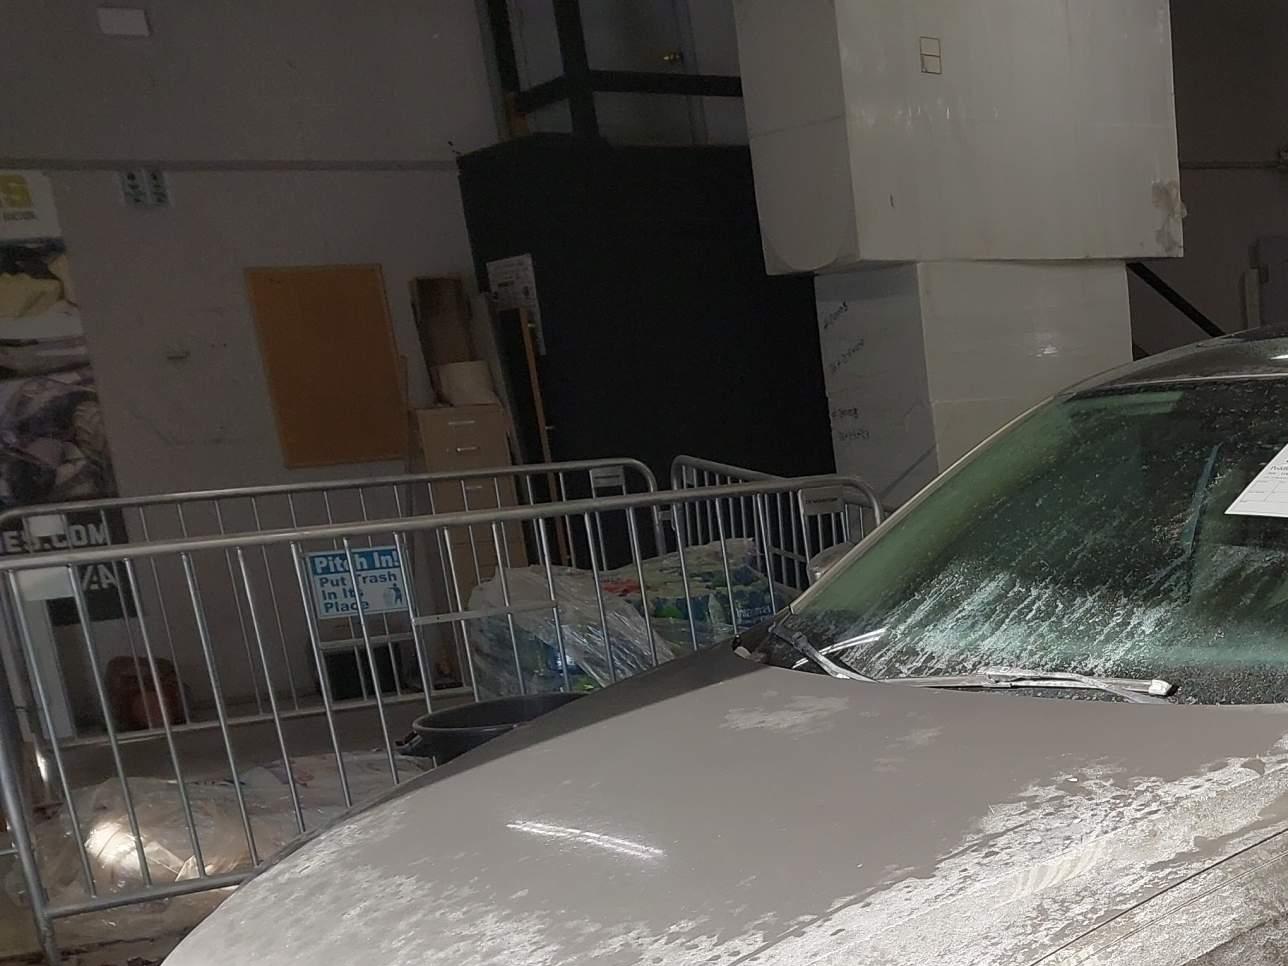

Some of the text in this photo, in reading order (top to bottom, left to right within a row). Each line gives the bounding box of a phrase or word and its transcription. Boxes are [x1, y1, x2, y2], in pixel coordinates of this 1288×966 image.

[373, 550, 400, 569] In!
[319, 577, 347, 588] Put
[321, 590, 337, 601] In
[324, 601, 369, 614] Place
